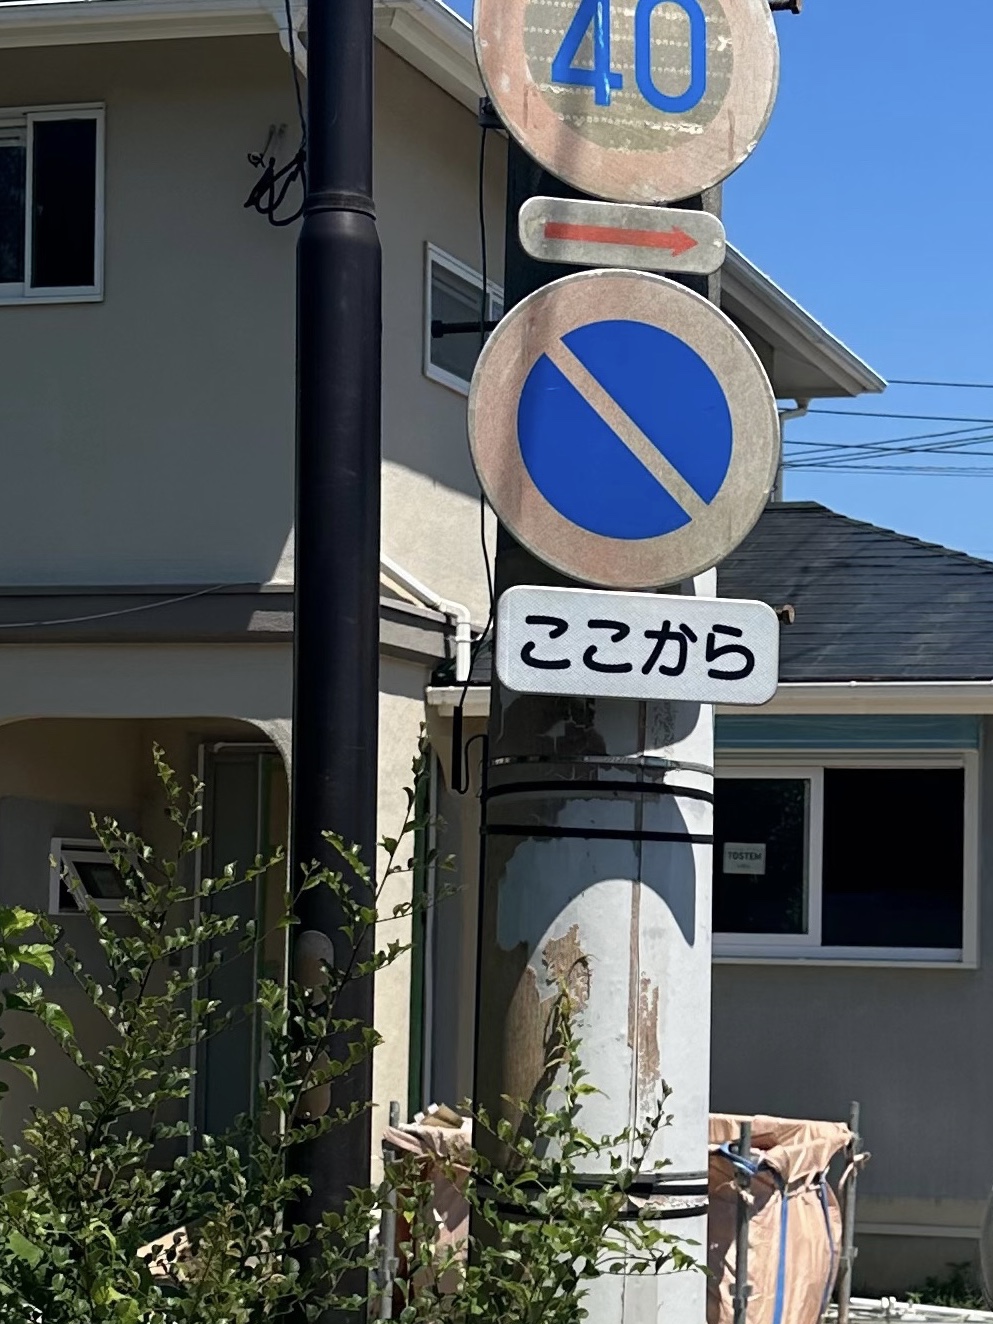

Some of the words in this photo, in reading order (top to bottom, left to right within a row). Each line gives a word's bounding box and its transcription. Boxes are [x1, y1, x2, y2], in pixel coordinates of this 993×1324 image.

[551, 0, 706, 113] 40
[520, 616, 755, 680] ここから
